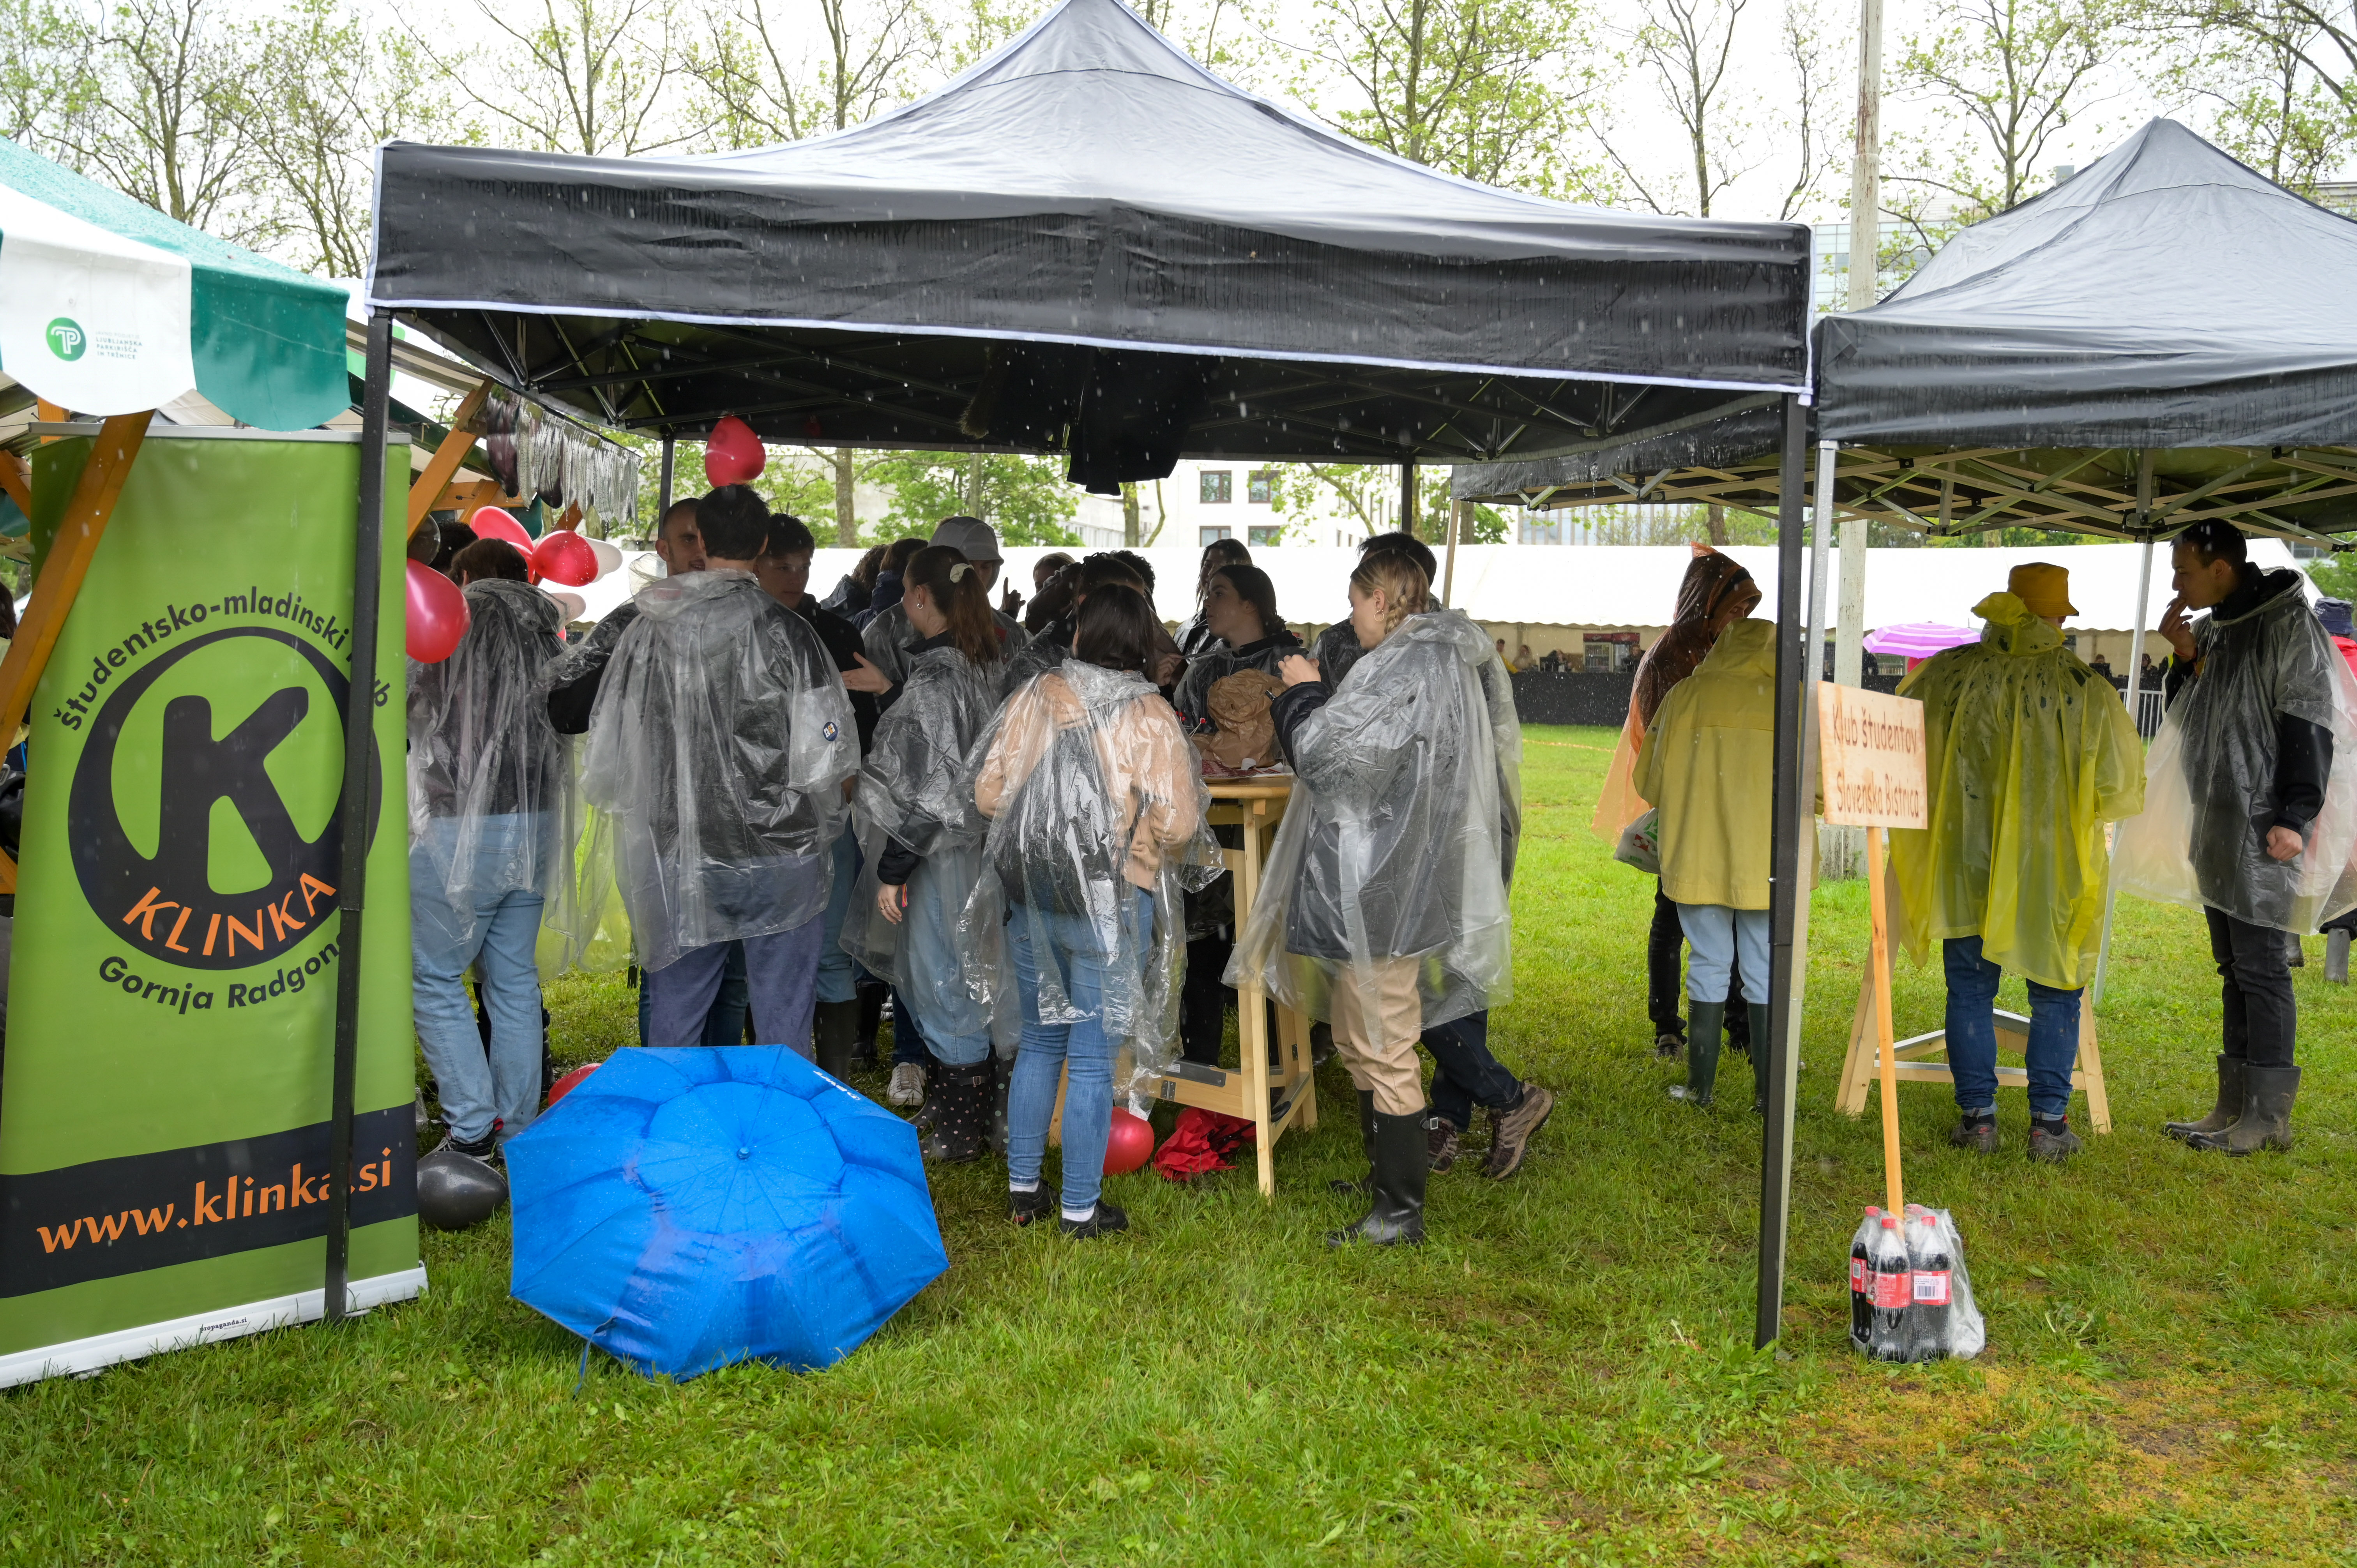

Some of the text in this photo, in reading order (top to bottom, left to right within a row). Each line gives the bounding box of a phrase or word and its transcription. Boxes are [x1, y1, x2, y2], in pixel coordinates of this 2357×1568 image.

[96, 336, 143, 346] LJUBLJANSKA
[97, 343, 137, 353] PARKIRIŠČA
[107, 351, 136, 360] TRŽNICE
[53, 586, 349, 731] študentsko-mladinski
[1832, 703, 1917, 755] Klub študentov
[1836, 771, 1919, 818] Slovenska Bistrica
[123, 872, 337, 957] KLINKA
[99, 956, 214, 1015] Gornja
